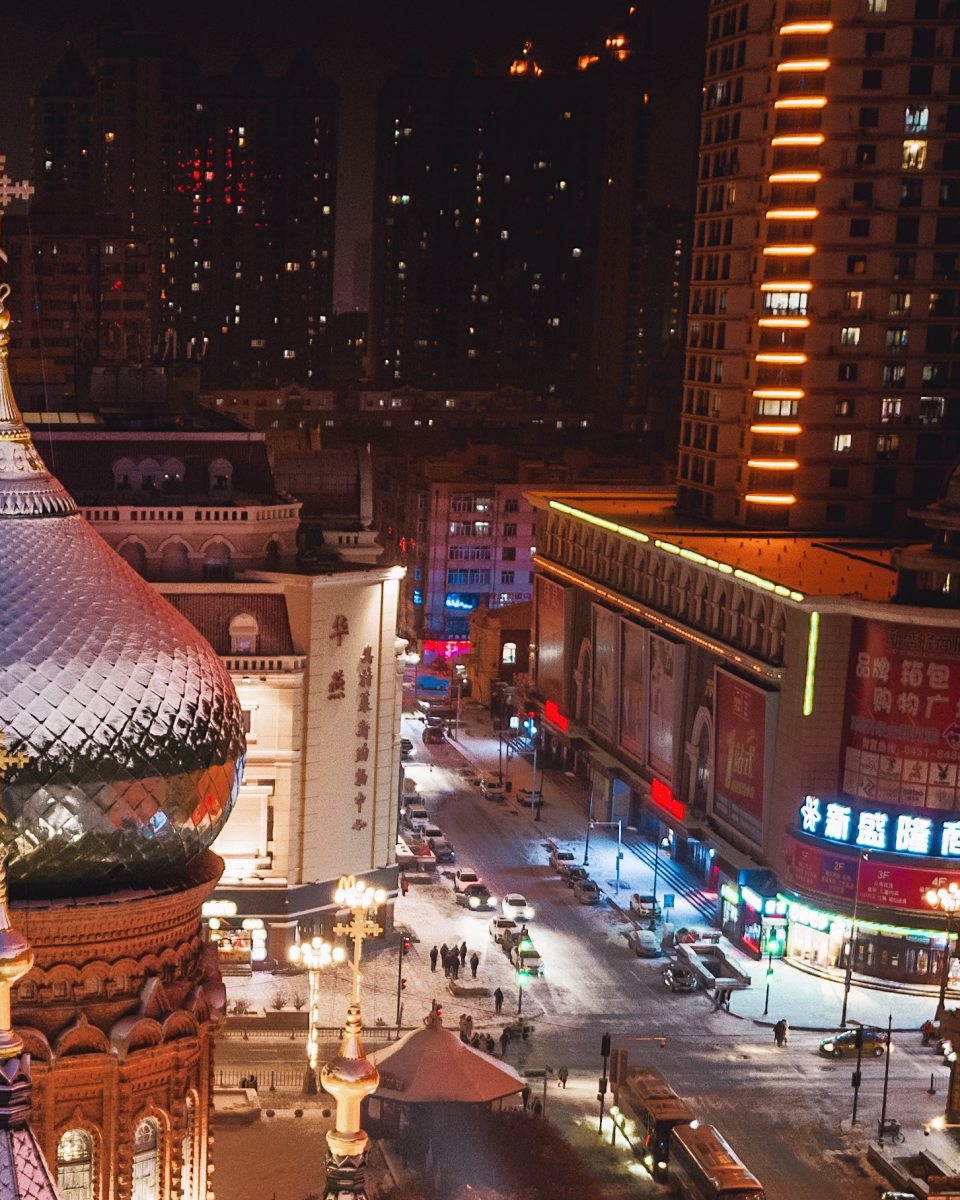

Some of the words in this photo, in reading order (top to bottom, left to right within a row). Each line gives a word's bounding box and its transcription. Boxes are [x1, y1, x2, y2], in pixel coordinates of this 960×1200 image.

[900, 658, 951, 690] 箱包
[877, 870, 891, 880] 3F
[931, 877, 948, 887] 4F
